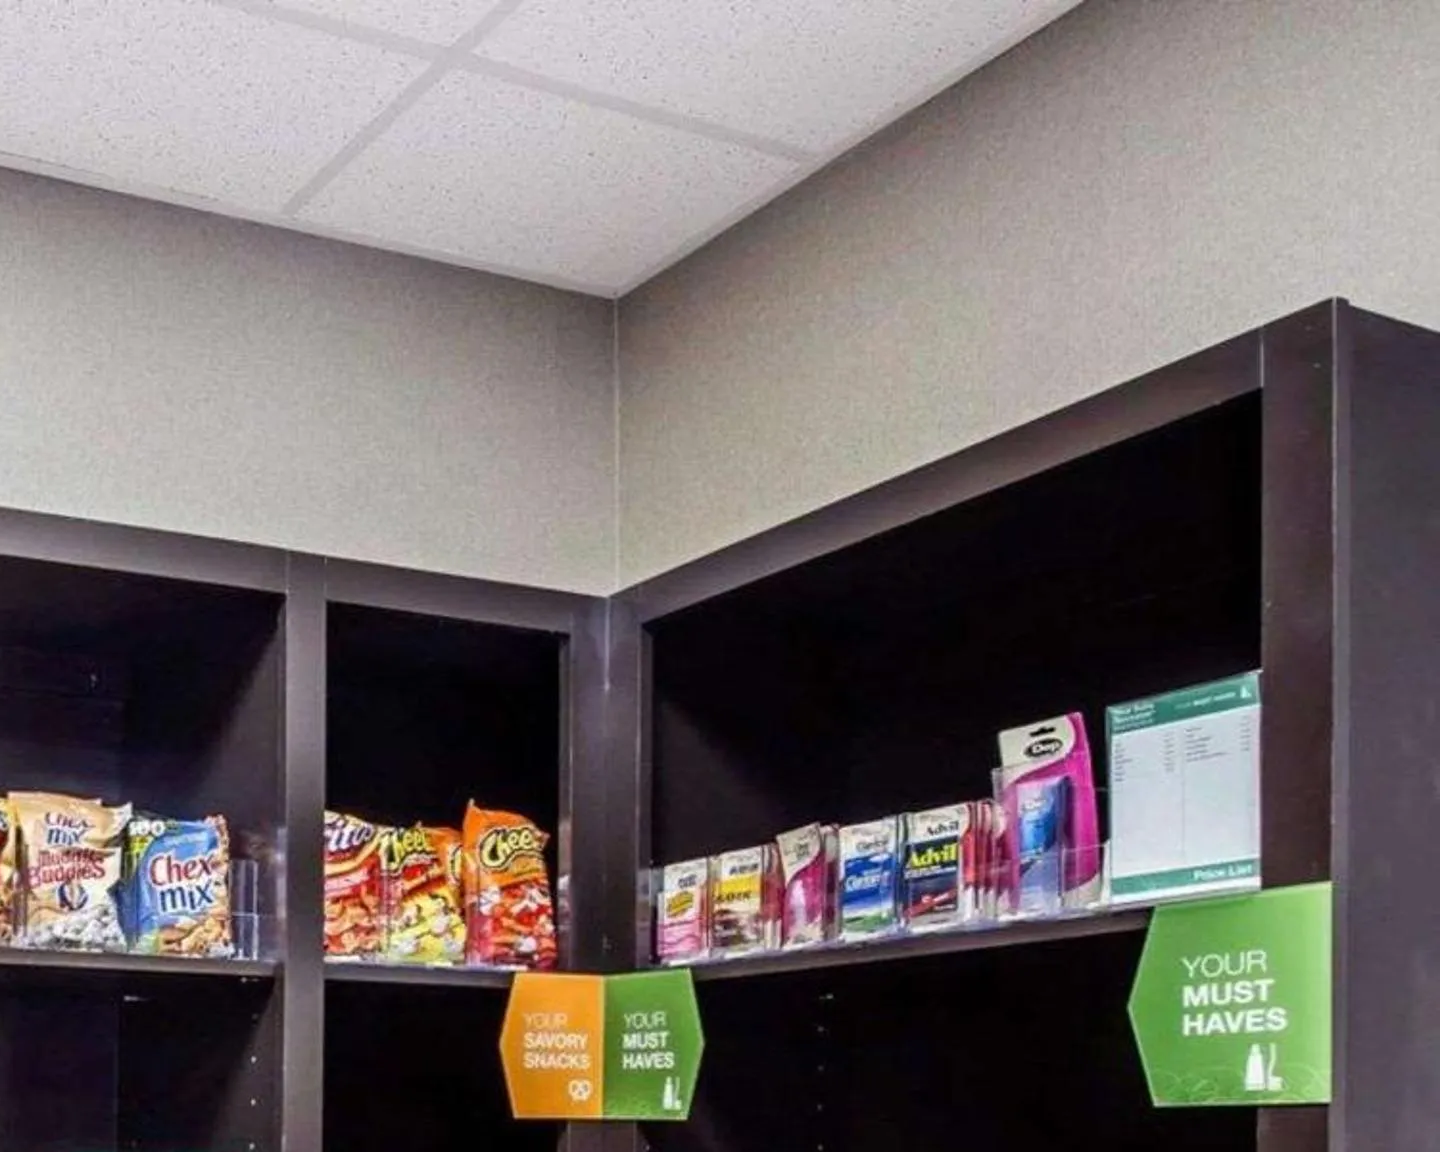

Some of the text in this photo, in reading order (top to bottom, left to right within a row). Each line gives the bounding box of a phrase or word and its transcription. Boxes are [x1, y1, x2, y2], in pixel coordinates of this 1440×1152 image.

[481, 827, 540, 868] Chee
[905, 842, 959, 869] Advil
[150, 853, 215, 887] Chex
[160, 879, 214, 912] mix
[1181, 949, 1269, 979] YOUR
[1182, 978, 1275, 1007] MUST
[523, 1012, 568, 1030] YOUR
[623, 1011, 666, 1030] YOUR
[1182, 1006, 1288, 1036] HAVES
[523, 1032, 589, 1051] SAVORY
[621, 1031, 670, 1050] MUST
[523, 1053, 591, 1070] SNACKS
[622, 1052, 676, 1070] HAVES
